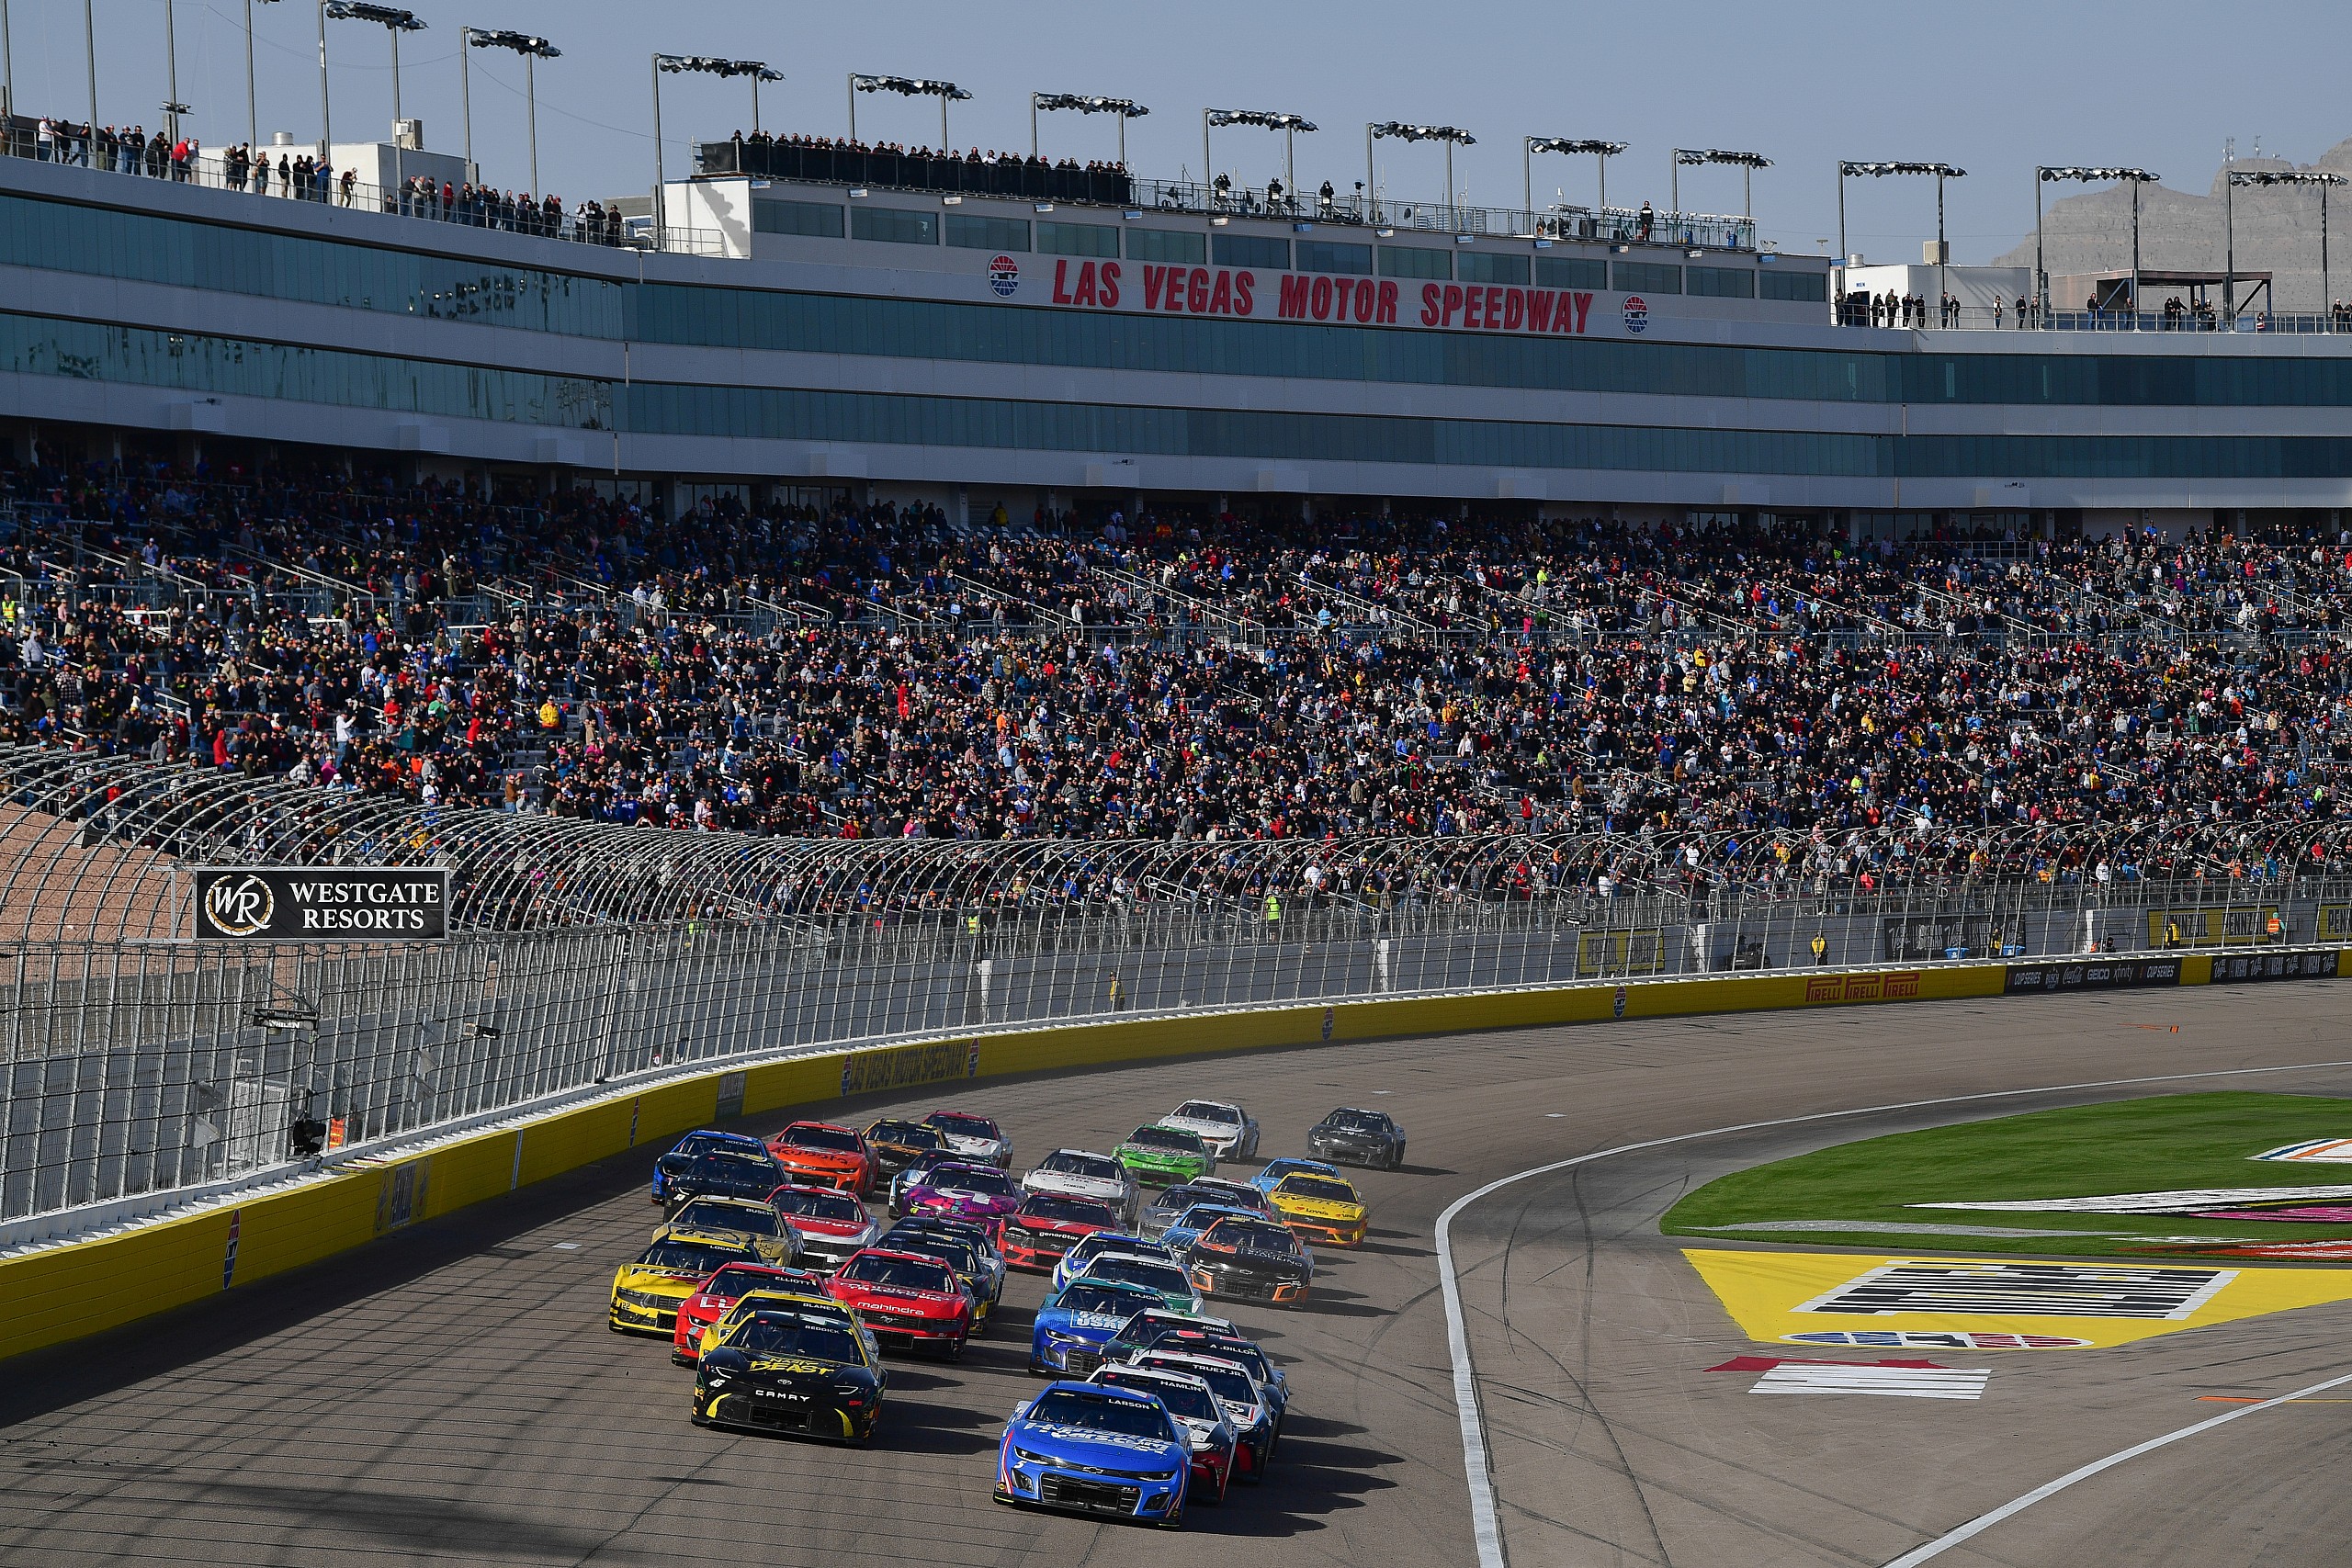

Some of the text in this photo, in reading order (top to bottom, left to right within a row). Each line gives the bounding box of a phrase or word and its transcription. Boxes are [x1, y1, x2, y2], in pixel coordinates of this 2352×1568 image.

[1052, 259, 1594, 333] LAS VEGAS MOTOR SPEEDWAY
[288, 883, 440, 904] WESTGATE
[214, 877, 272, 930] WR
[302, 908, 424, 930] RESORTS
[2086, 967, 2110, 980] GEICO
[2113, 964, 2133, 982] xfinity
[2156, 964, 2175, 977] SERIES
[1805, 976, 1843, 1002] PIRELLI
[1844, 975, 1882, 1000] PIRELLI
[1883, 972, 1921, 998] PIRELLI
[746, 1207, 774, 1216] BUSCH
[709, 1245, 743, 1254] LOGANO
[775, 1275, 811, 1286] ELLIOTT
[802, 1302, 837, 1313] BLANEY
[857, 1302, 925, 1316] mahindra
[804, 1325, 841, 1335] REDDICK
[1201, 1325, 1231, 1335] JONES
[748, 1360, 834, 1376] BEAST
[1193, 1363, 1245, 1378] TRUEX JR.
[1159, 1380, 1203, 1393] HAMLIN
[755, 1389, 811, 1403] CAMRY
[1107, 1398, 1151, 1411] LARSON
[1013, 1461, 1027, 1470] 5
